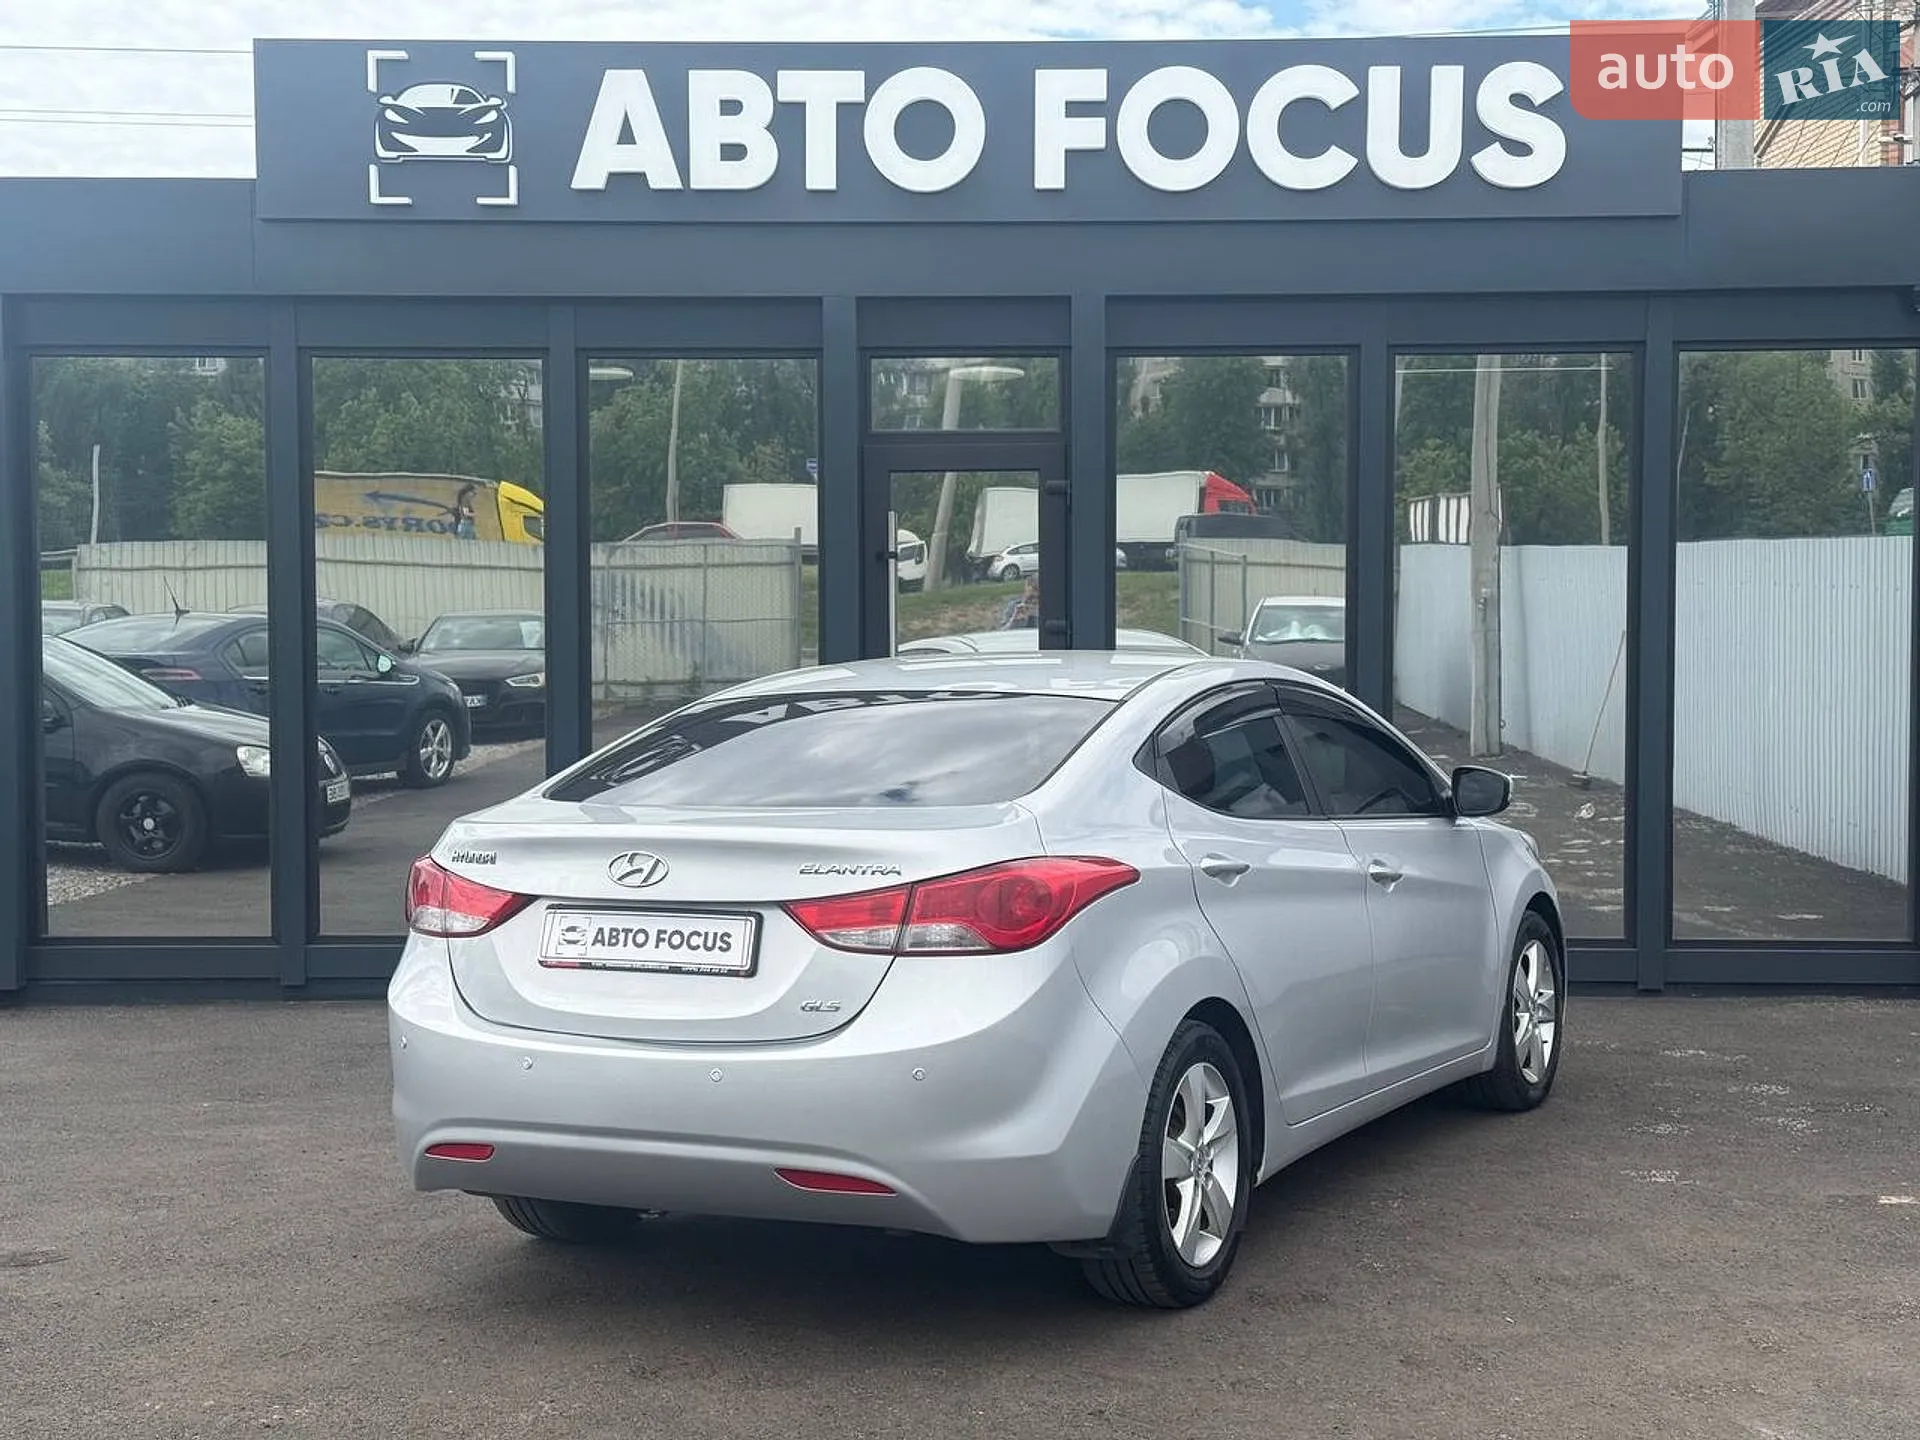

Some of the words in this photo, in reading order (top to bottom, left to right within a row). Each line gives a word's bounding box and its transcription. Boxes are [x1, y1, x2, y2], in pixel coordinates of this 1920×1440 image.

[571, 67, 985, 191] АВТО
[1035, 62, 1565, 190] FOCUS
[799, 863, 902, 876] ELANTRA
[591, 926, 650, 948] АВТО
[654, 930, 733, 953] FOCUS
[800, 999, 842, 1013] GLS
